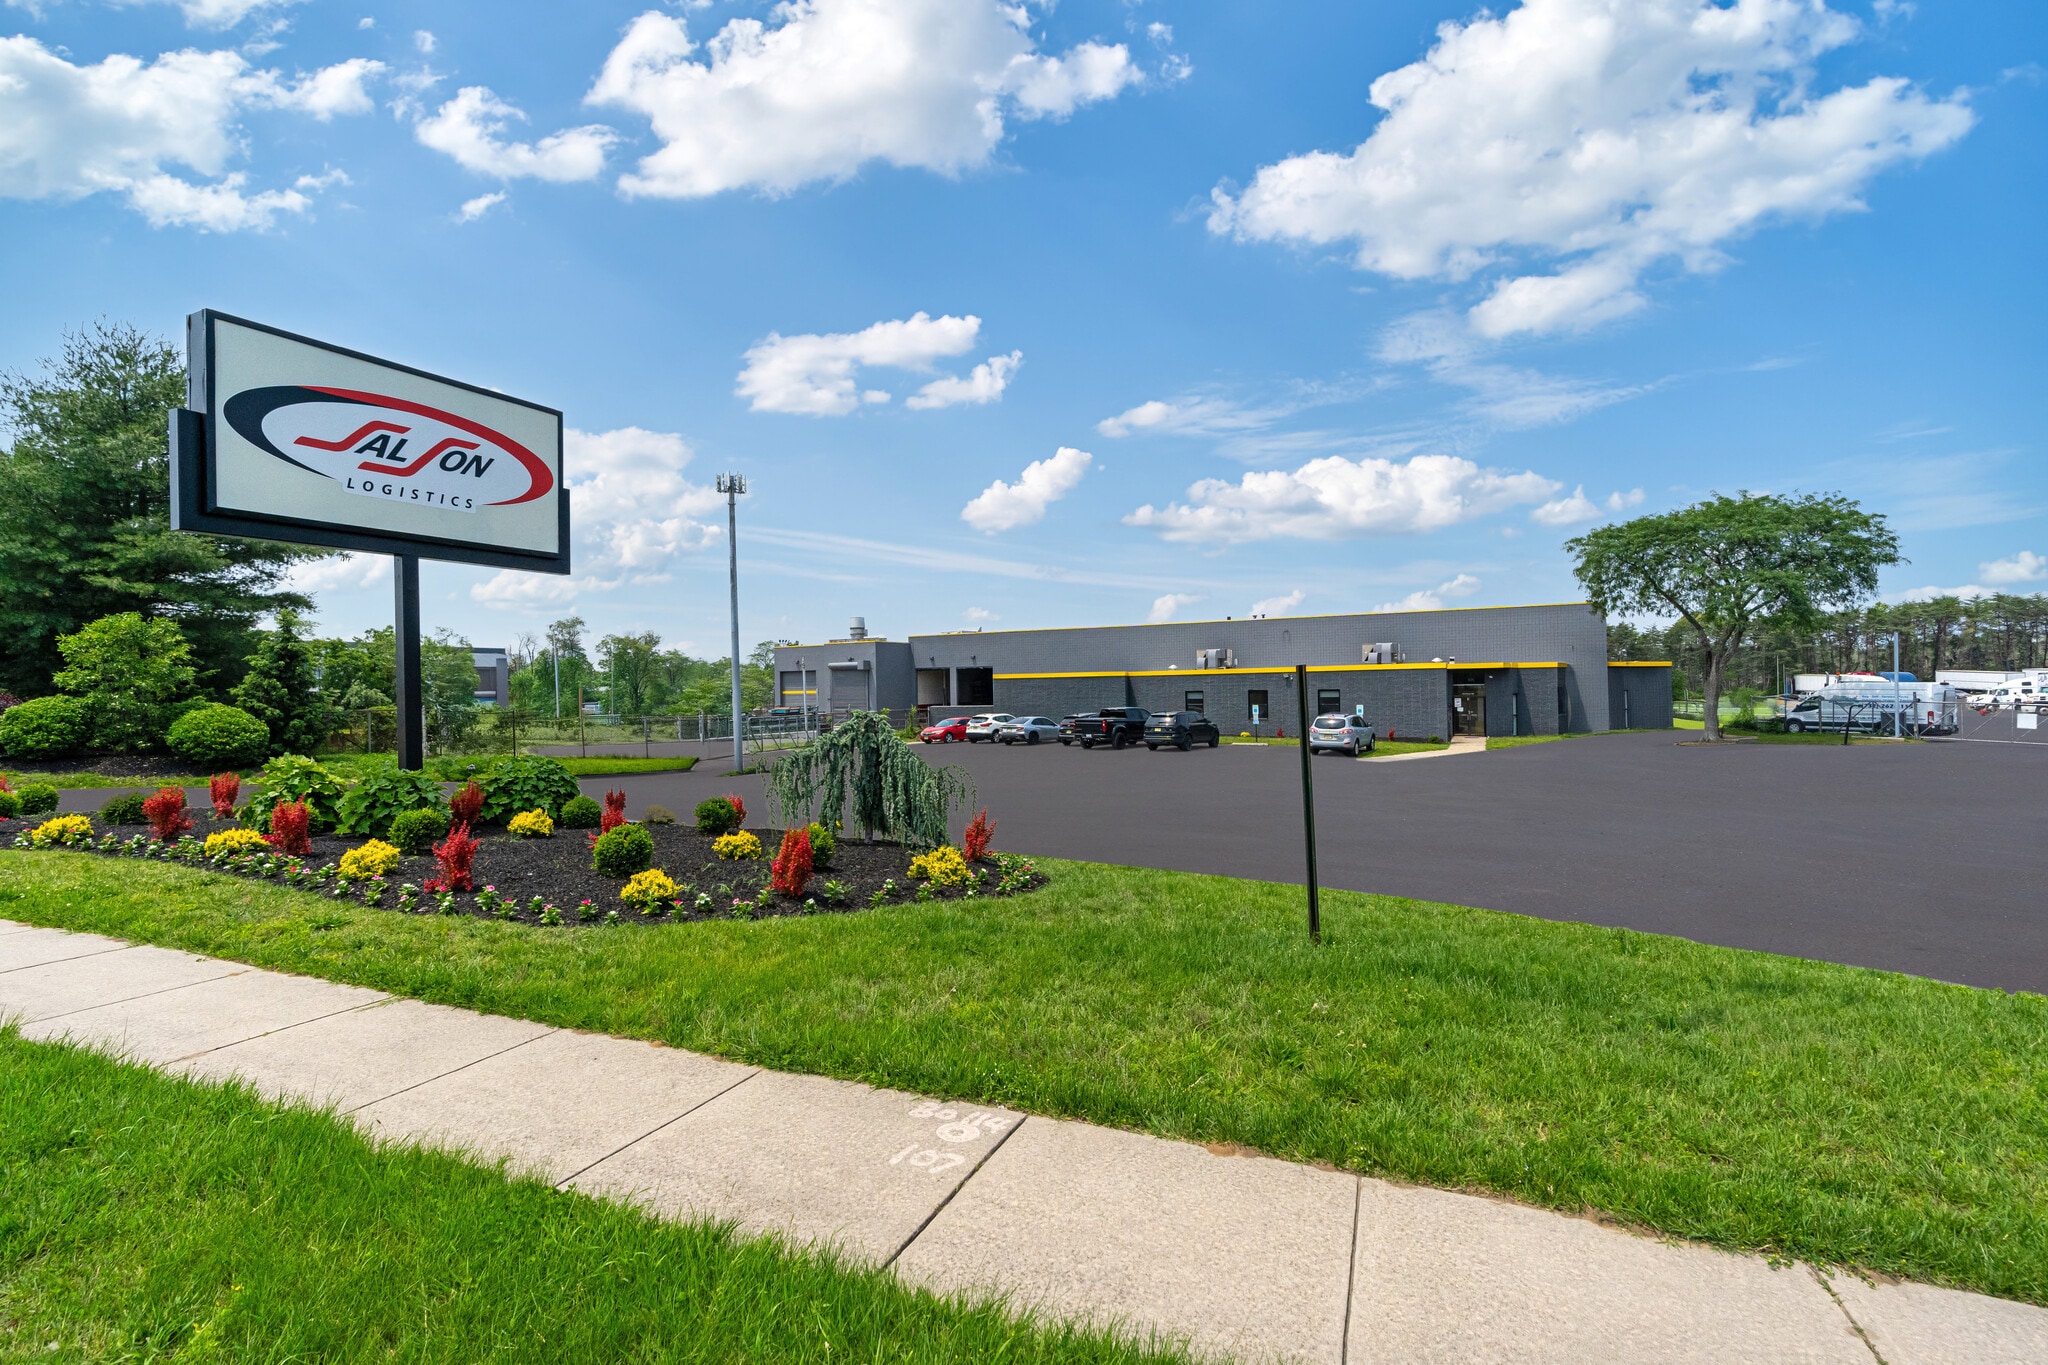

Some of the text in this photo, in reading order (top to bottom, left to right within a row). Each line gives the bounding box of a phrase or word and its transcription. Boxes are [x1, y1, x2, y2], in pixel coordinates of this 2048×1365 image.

[293, 420, 495, 478] SALSON
[346, 477, 474, 509] LOGISTICS
[889, 1143, 966, 1174] 107
